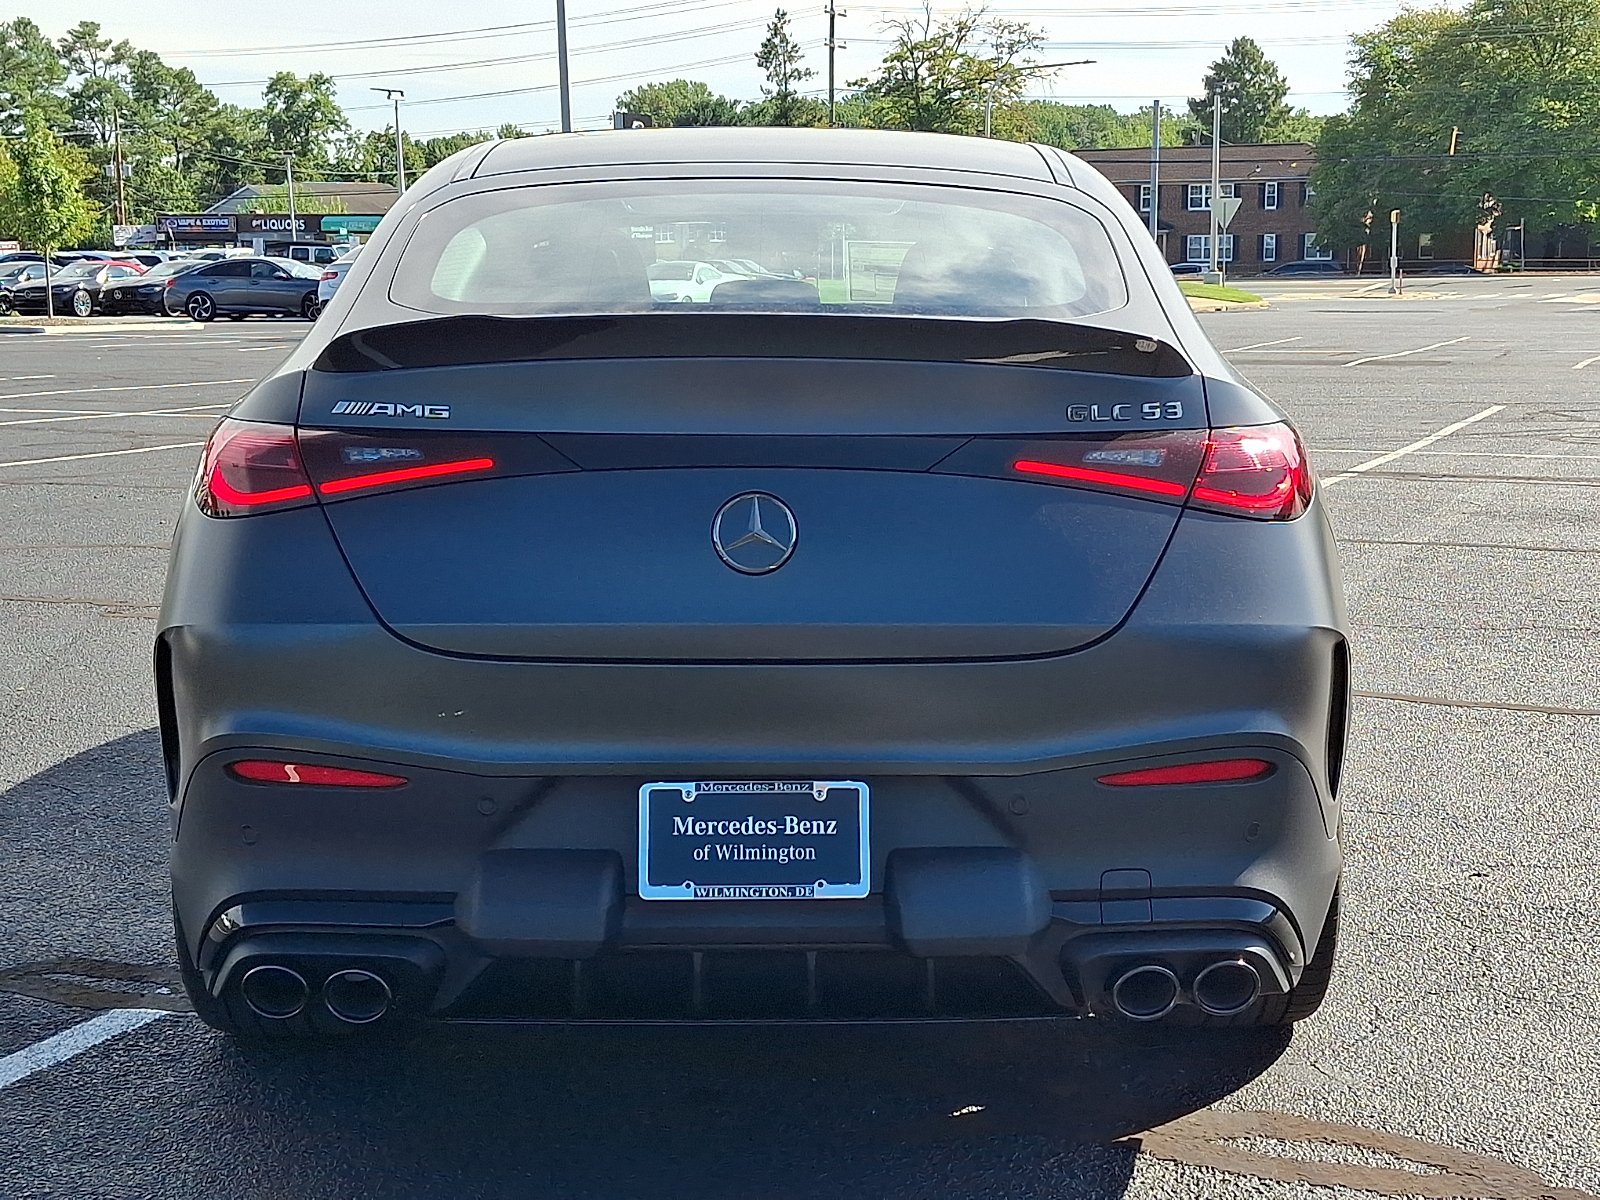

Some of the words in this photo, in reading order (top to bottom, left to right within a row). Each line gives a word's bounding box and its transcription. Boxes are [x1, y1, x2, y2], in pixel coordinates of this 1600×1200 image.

[202, 218, 229, 226] EXOTICS
[261, 219, 305, 231] LIQUORS
[1066, 403, 1132, 421] GLC
[1140, 401, 1183, 420] 53
[700, 782, 811, 792] Mercedes-Benz
[672, 816, 838, 836] Mercedes-Benz
[693, 844, 712, 861] of
[715, 843, 817, 864] Wilmington
[695, 886, 793, 898] WILMINGTON,
[795, 887, 813, 897] DE
